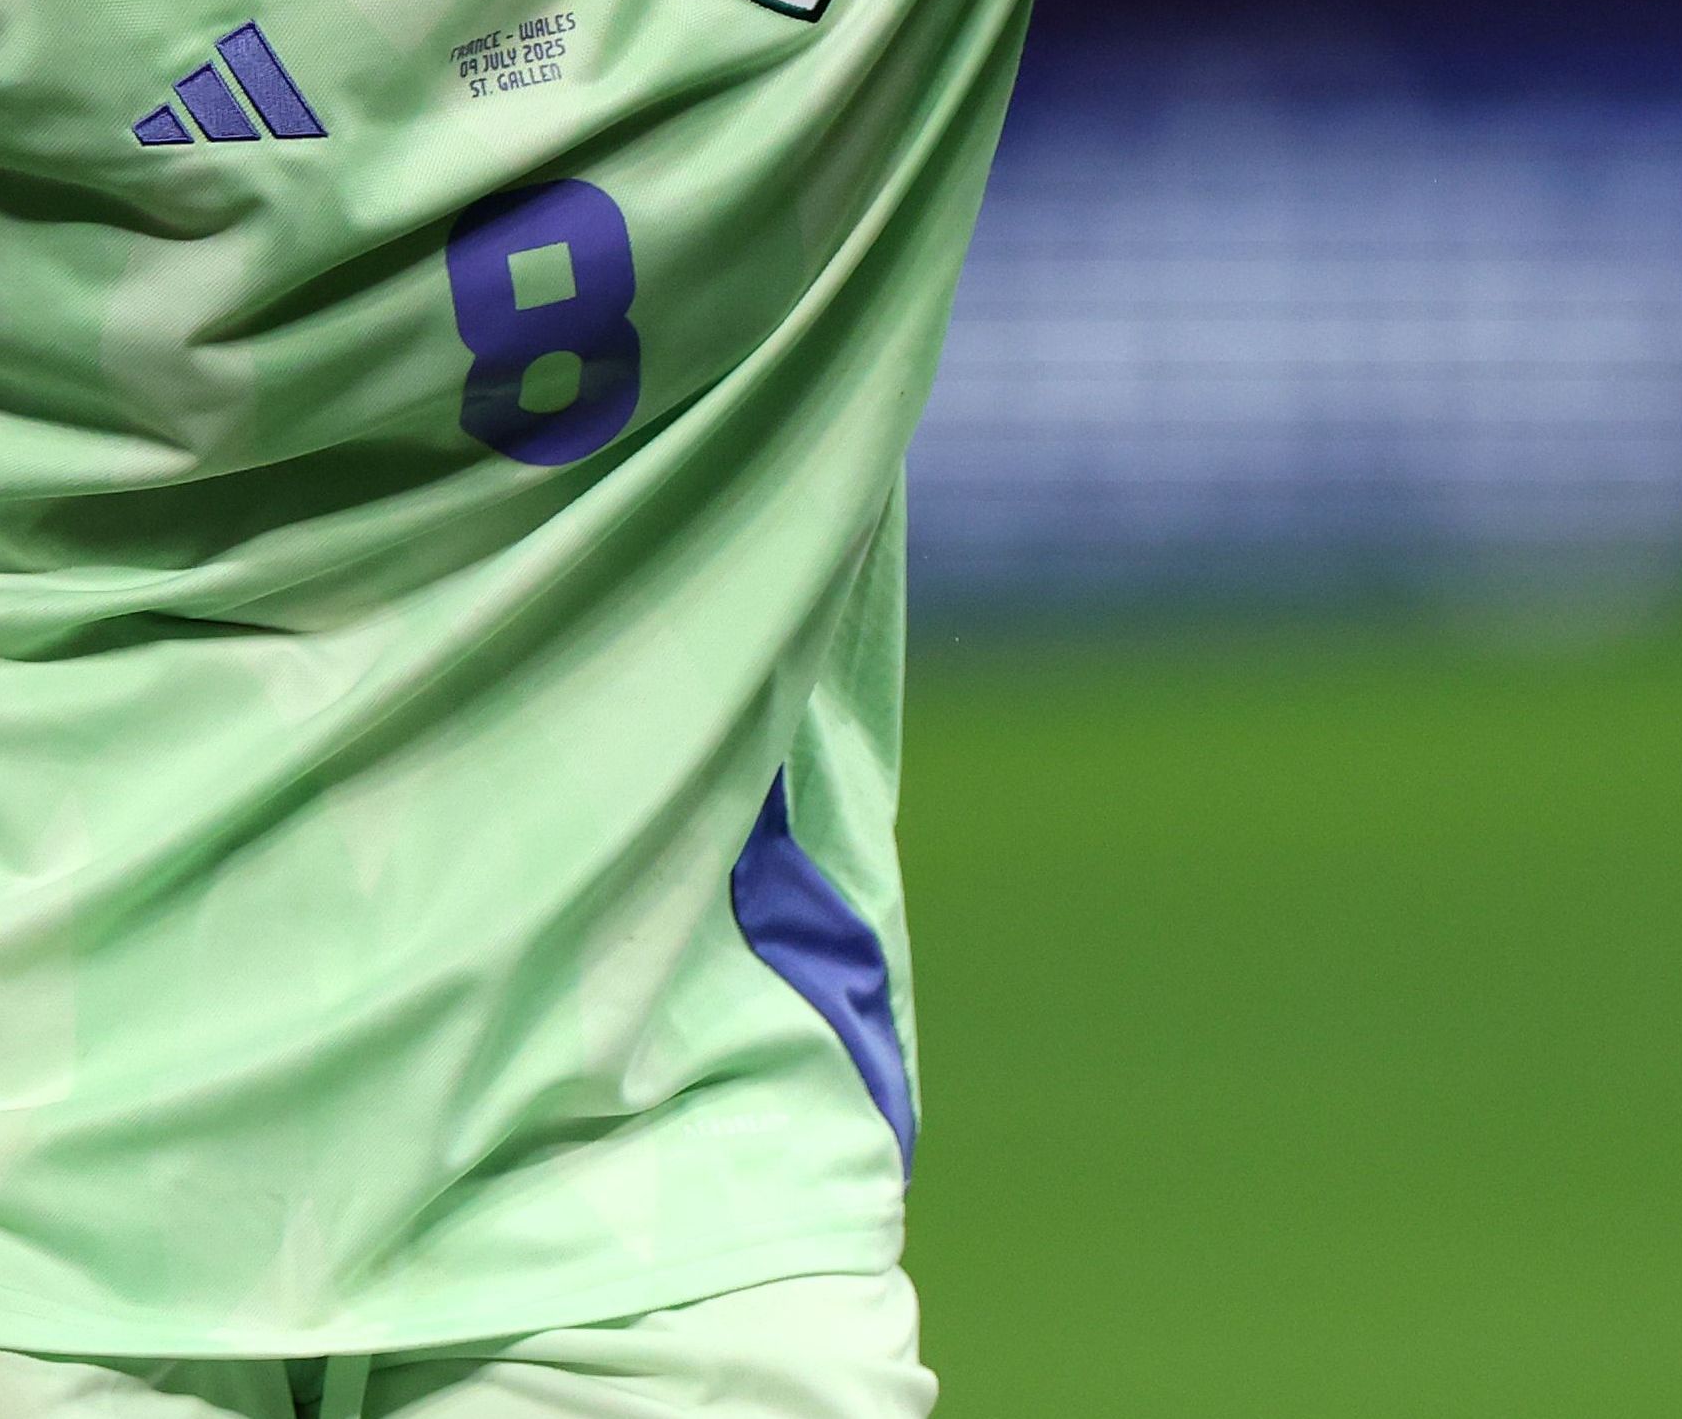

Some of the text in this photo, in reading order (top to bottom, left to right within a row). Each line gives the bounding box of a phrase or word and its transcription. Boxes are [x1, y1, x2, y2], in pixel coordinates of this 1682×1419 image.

[450, 30, 501, 62] FRANCE
[519, 12, 576, 41] WALES
[460, 39, 566, 78] 09 JULY 2025
[470, 63, 562, 98] ST. GALLEN
[445, 178, 641, 466] 8
